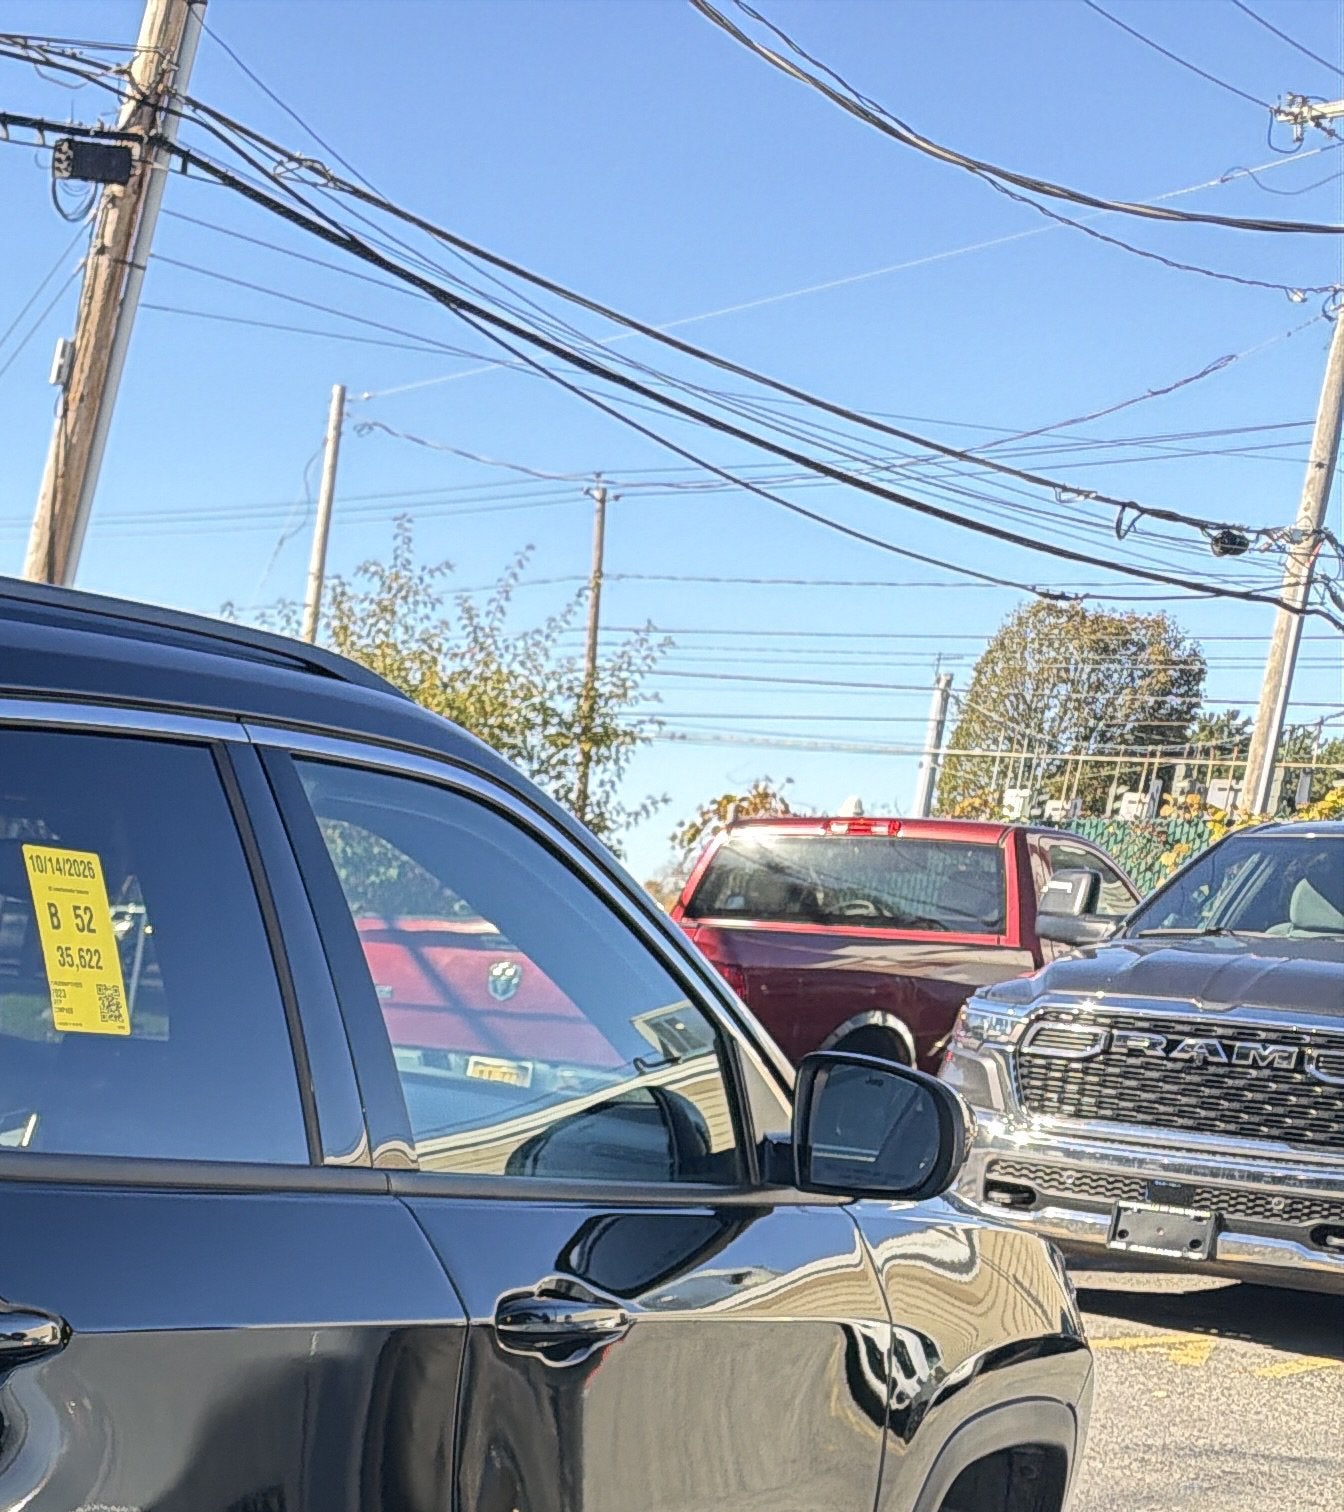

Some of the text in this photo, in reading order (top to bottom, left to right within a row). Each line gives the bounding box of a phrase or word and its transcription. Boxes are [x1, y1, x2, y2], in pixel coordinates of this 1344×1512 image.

[28, 855, 95, 879] 10/14/2026
[47, 902, 97, 934] B 52
[56, 945, 103, 972] 35,622
[1111, 1028, 1299, 1070] RAM
